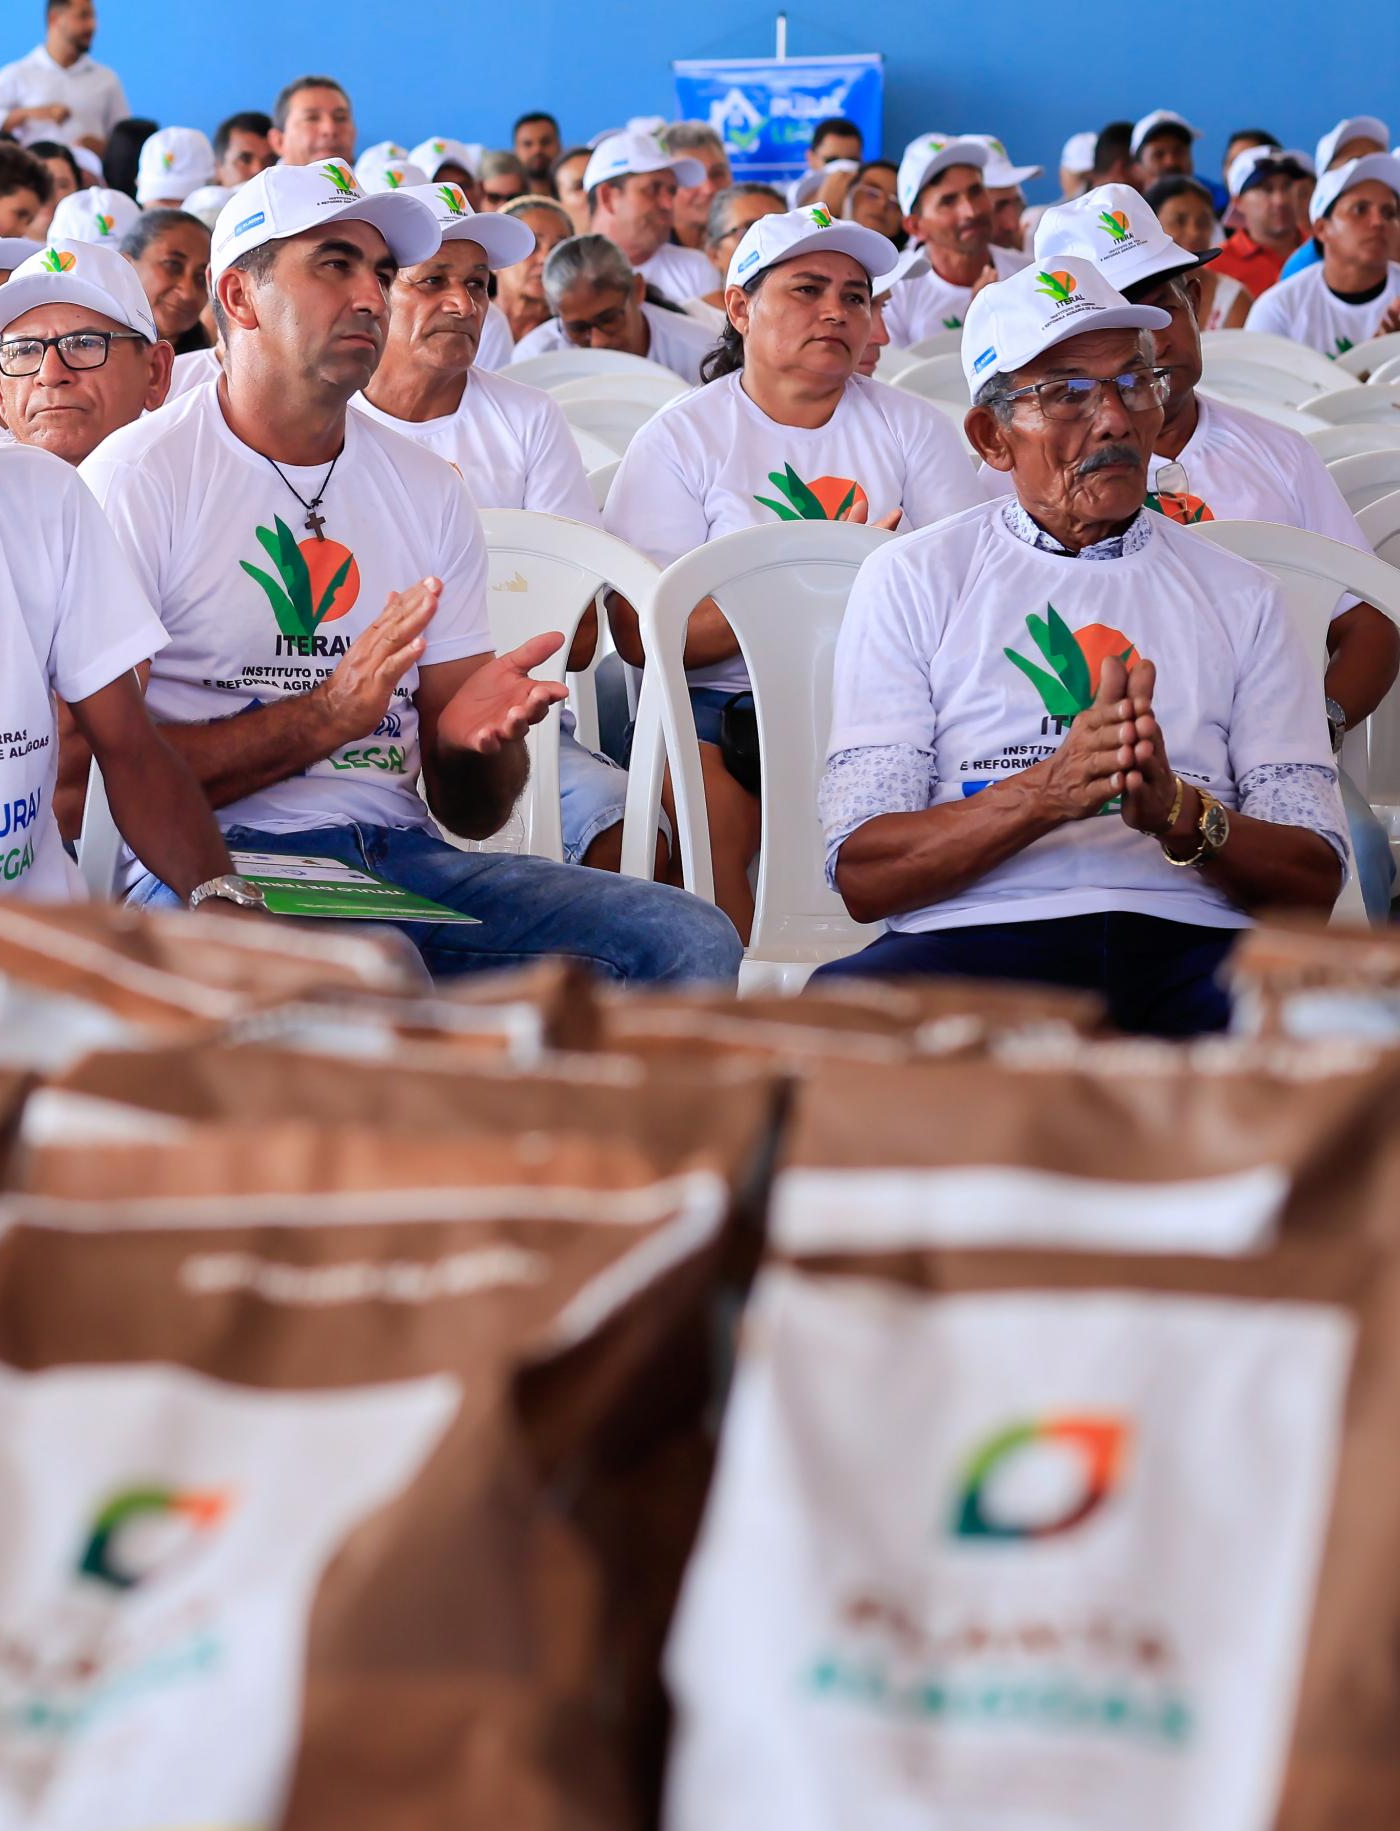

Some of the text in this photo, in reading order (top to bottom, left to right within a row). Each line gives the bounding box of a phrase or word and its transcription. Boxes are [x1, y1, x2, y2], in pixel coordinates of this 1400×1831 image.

[1055, 294, 1086, 309] ITERAL
[241, 666, 334, 678] INSTITUTO DE
[203, 678, 323, 691] E REFORMA AGRÁ
[1003, 745, 1057, 756] INSTIT
[960, 757, 1040, 771] E REFORMA
